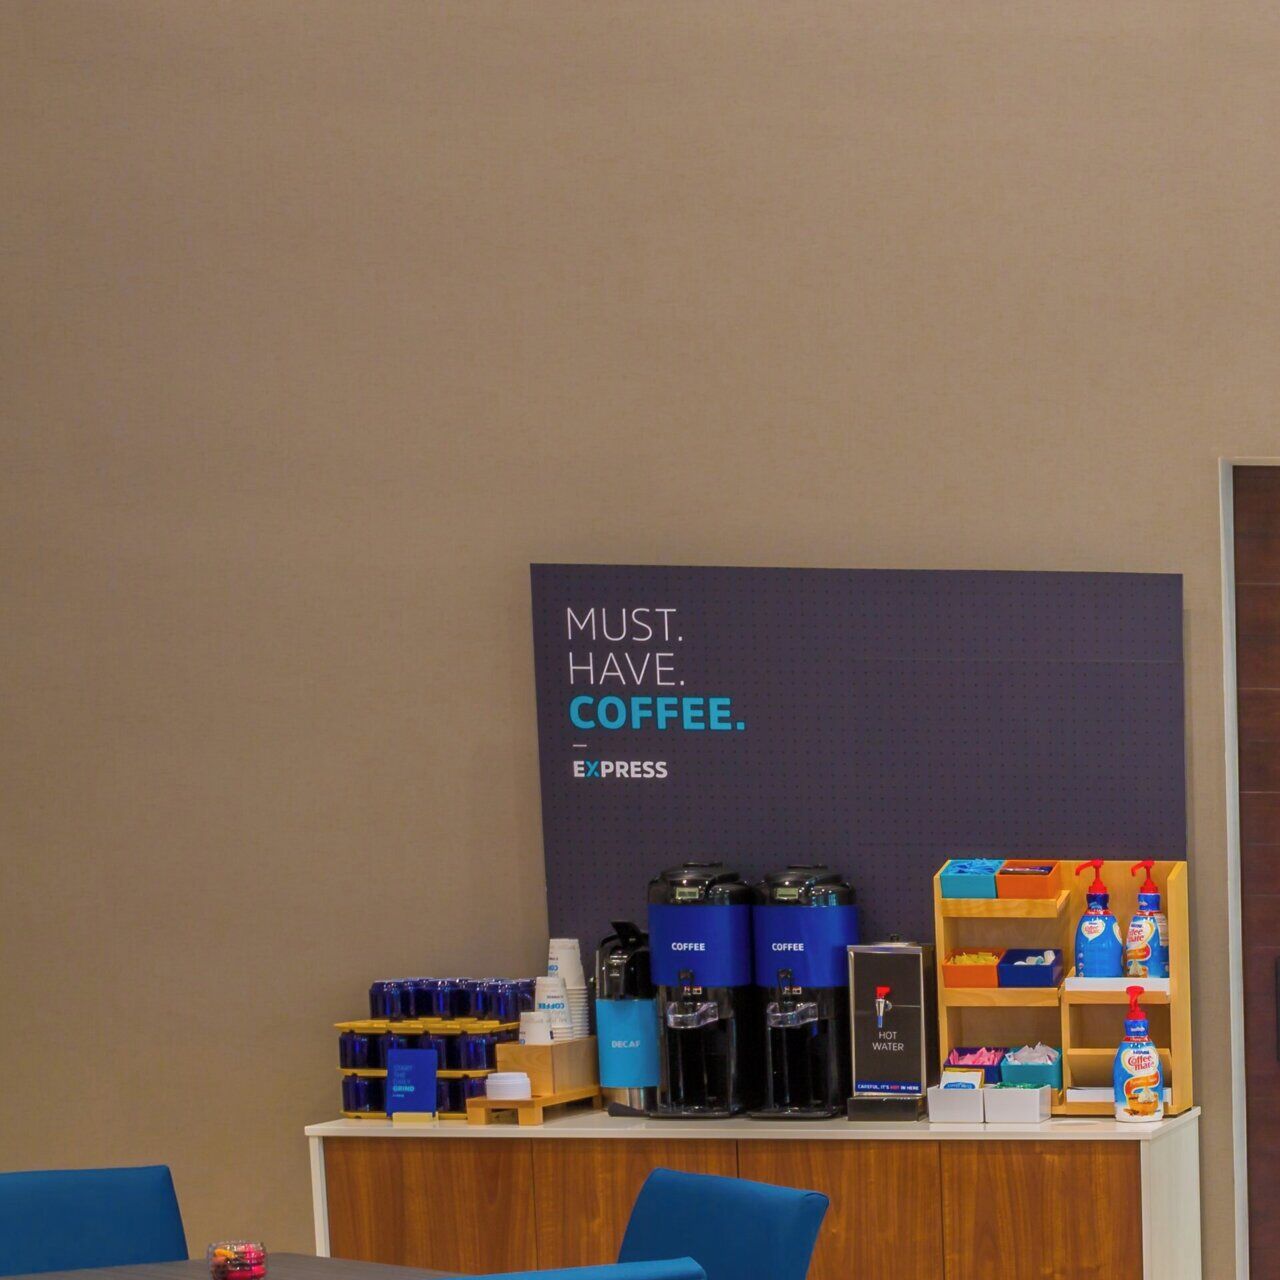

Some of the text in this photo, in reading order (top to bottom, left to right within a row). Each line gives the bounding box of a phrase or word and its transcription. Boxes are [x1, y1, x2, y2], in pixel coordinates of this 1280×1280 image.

[566, 606, 684, 642] MUST.
[569, 652, 685, 687] HAVE.
[569, 696, 746, 731] COFFEE.
[573, 761, 668, 779] EXPRESS
[671, 942, 706, 951] COFFEE
[772, 942, 804, 951] COFFEE
[879, 1031, 897, 1040] HOT
[611, 1040, 641, 1048] DECAF
[872, 1042, 904, 1051] WATER
